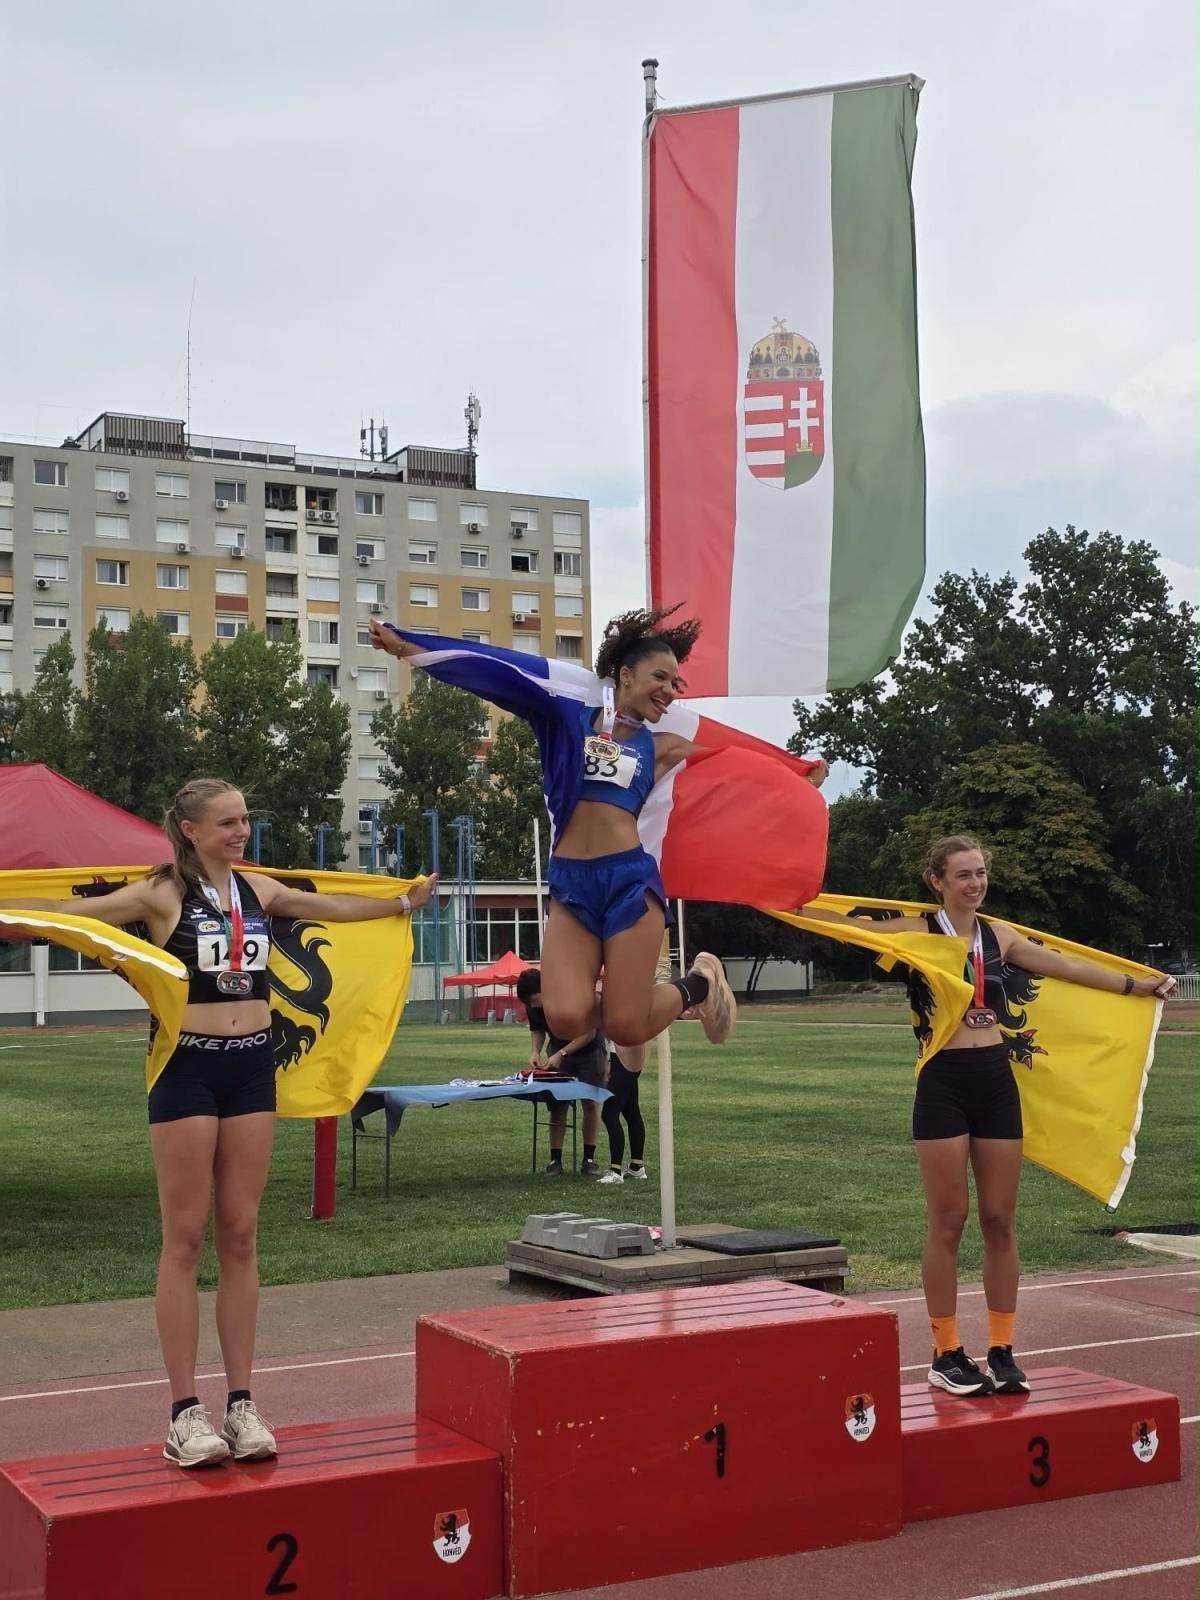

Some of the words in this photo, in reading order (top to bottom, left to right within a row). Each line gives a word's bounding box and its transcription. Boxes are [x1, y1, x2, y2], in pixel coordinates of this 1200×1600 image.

[585, 755, 618, 777] 83
[224, 1033, 267, 1051] PRO
[703, 1422, 726, 1479] 1
[1027, 1435, 1051, 1488] 3
[264, 1532, 298, 1596] 2
